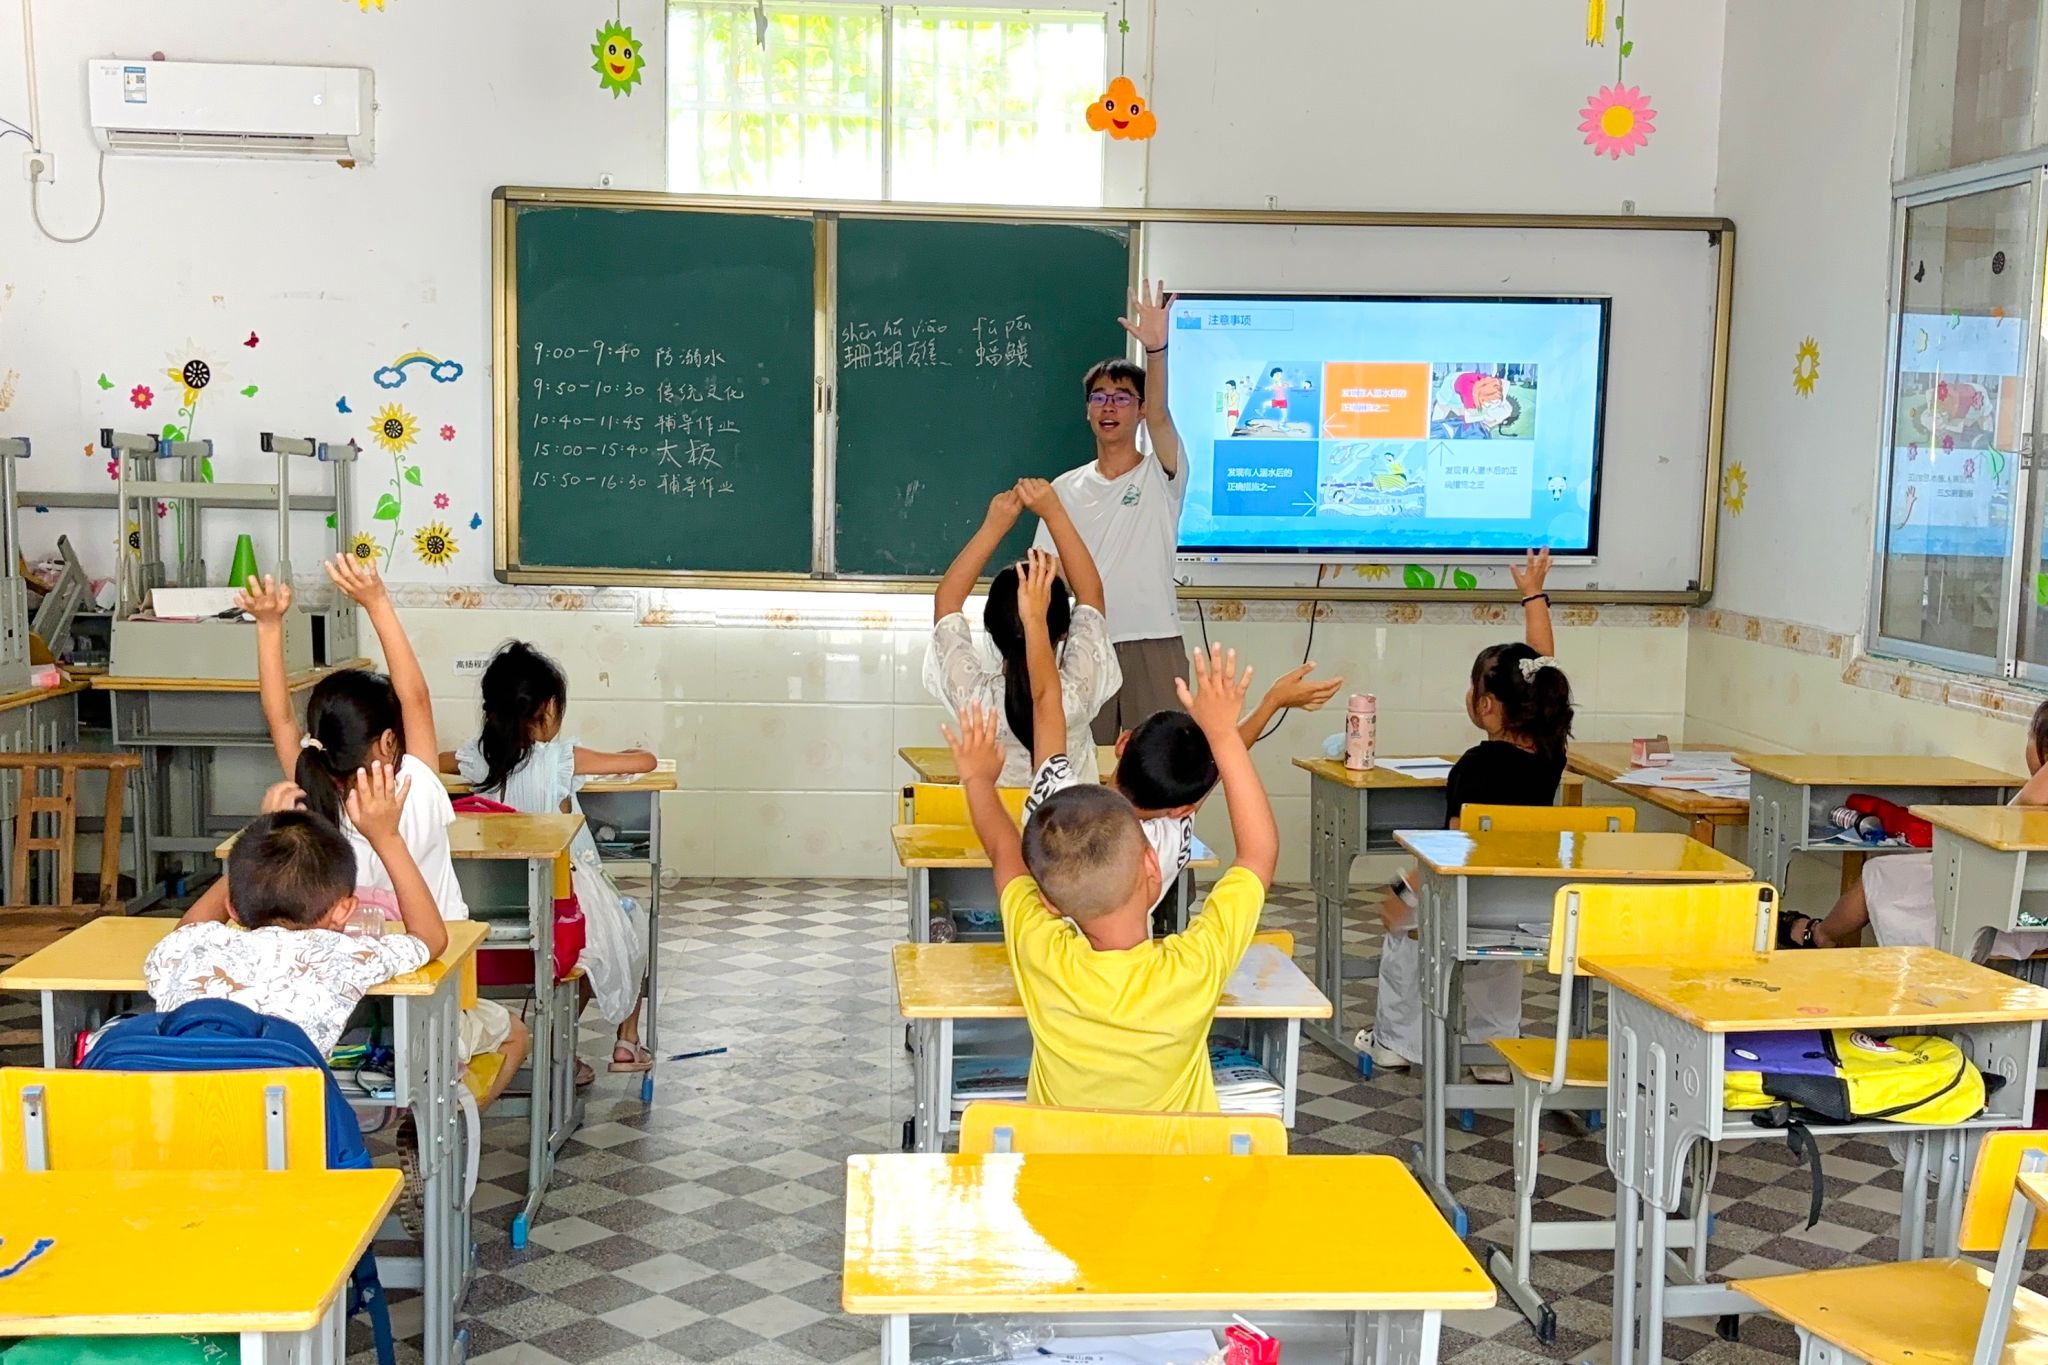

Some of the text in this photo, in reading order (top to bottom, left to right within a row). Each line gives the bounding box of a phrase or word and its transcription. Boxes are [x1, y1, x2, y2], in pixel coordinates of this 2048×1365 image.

[1208, 314, 1252, 327] 注意事项
[656, 347, 726, 368] 防溺水
[657, 382, 744, 403] 传统文化
[654, 412, 741, 437] 辅导作业
[657, 472, 735, 499] 辅导作业
